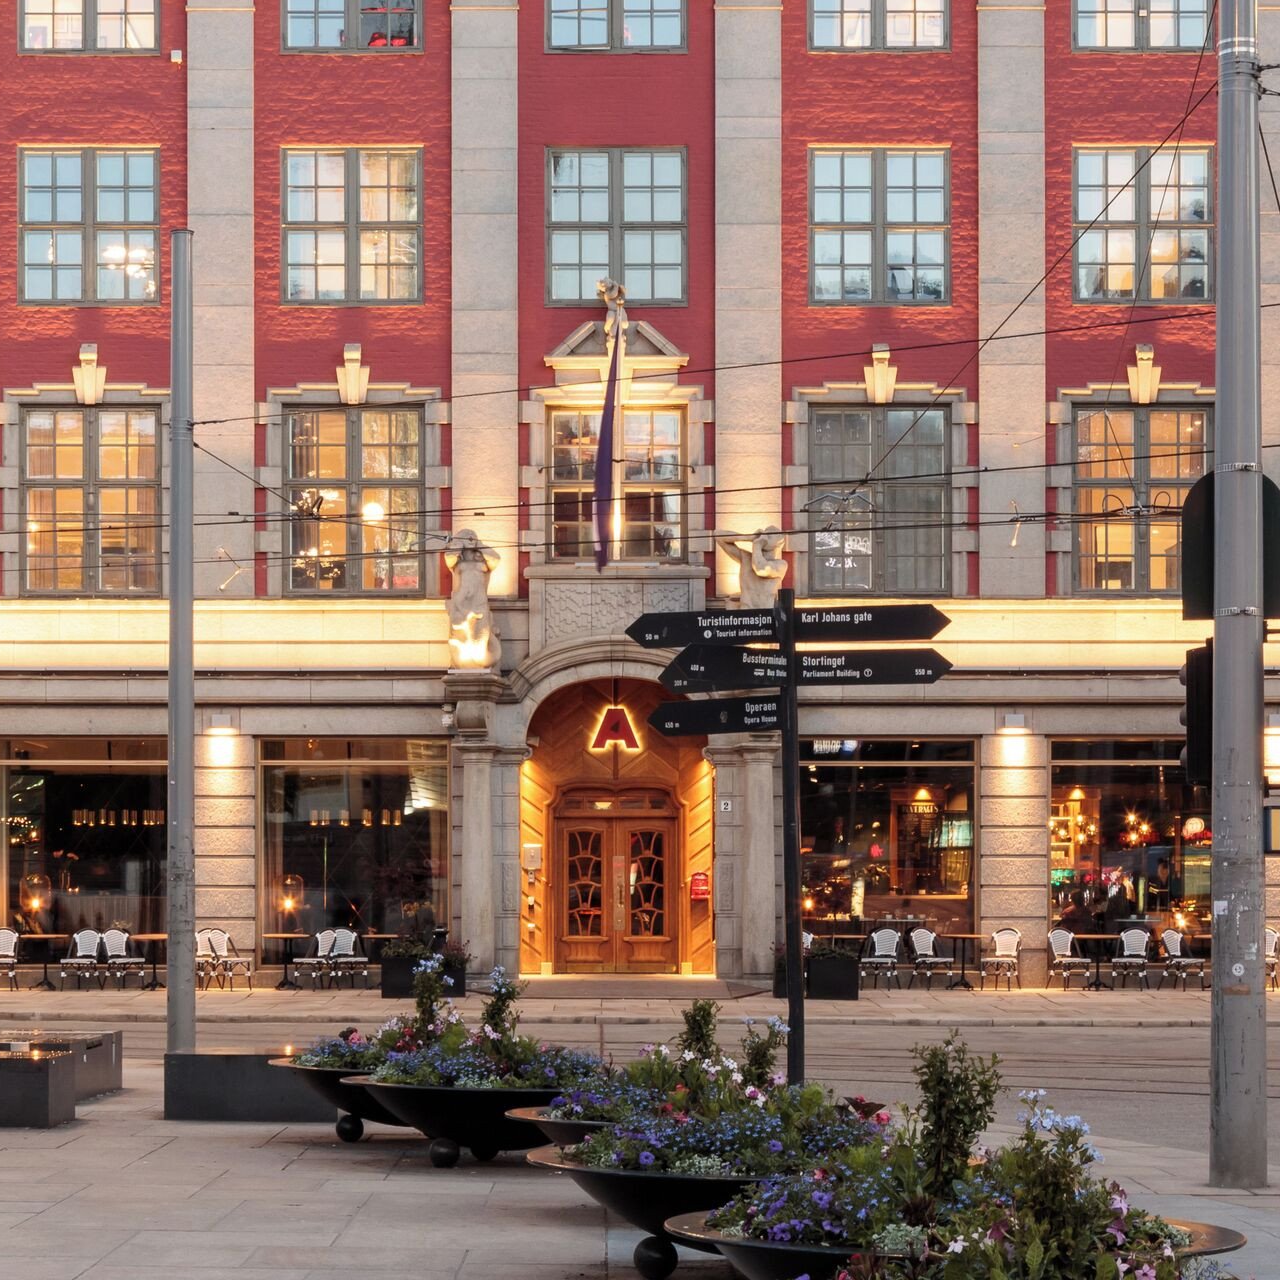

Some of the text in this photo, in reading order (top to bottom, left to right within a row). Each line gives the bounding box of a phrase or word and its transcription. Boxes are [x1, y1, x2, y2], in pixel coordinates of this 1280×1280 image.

[697, 615, 772, 627] Turistinformasjon
[801, 611, 873, 624] Karl Johans gate
[802, 655, 845, 668] Stortinget
[836, 669, 860, 678] Building
[745, 702, 777, 712] Operaen
[592, 707, 639, 749] A
[723, 801, 729, 810] 2
